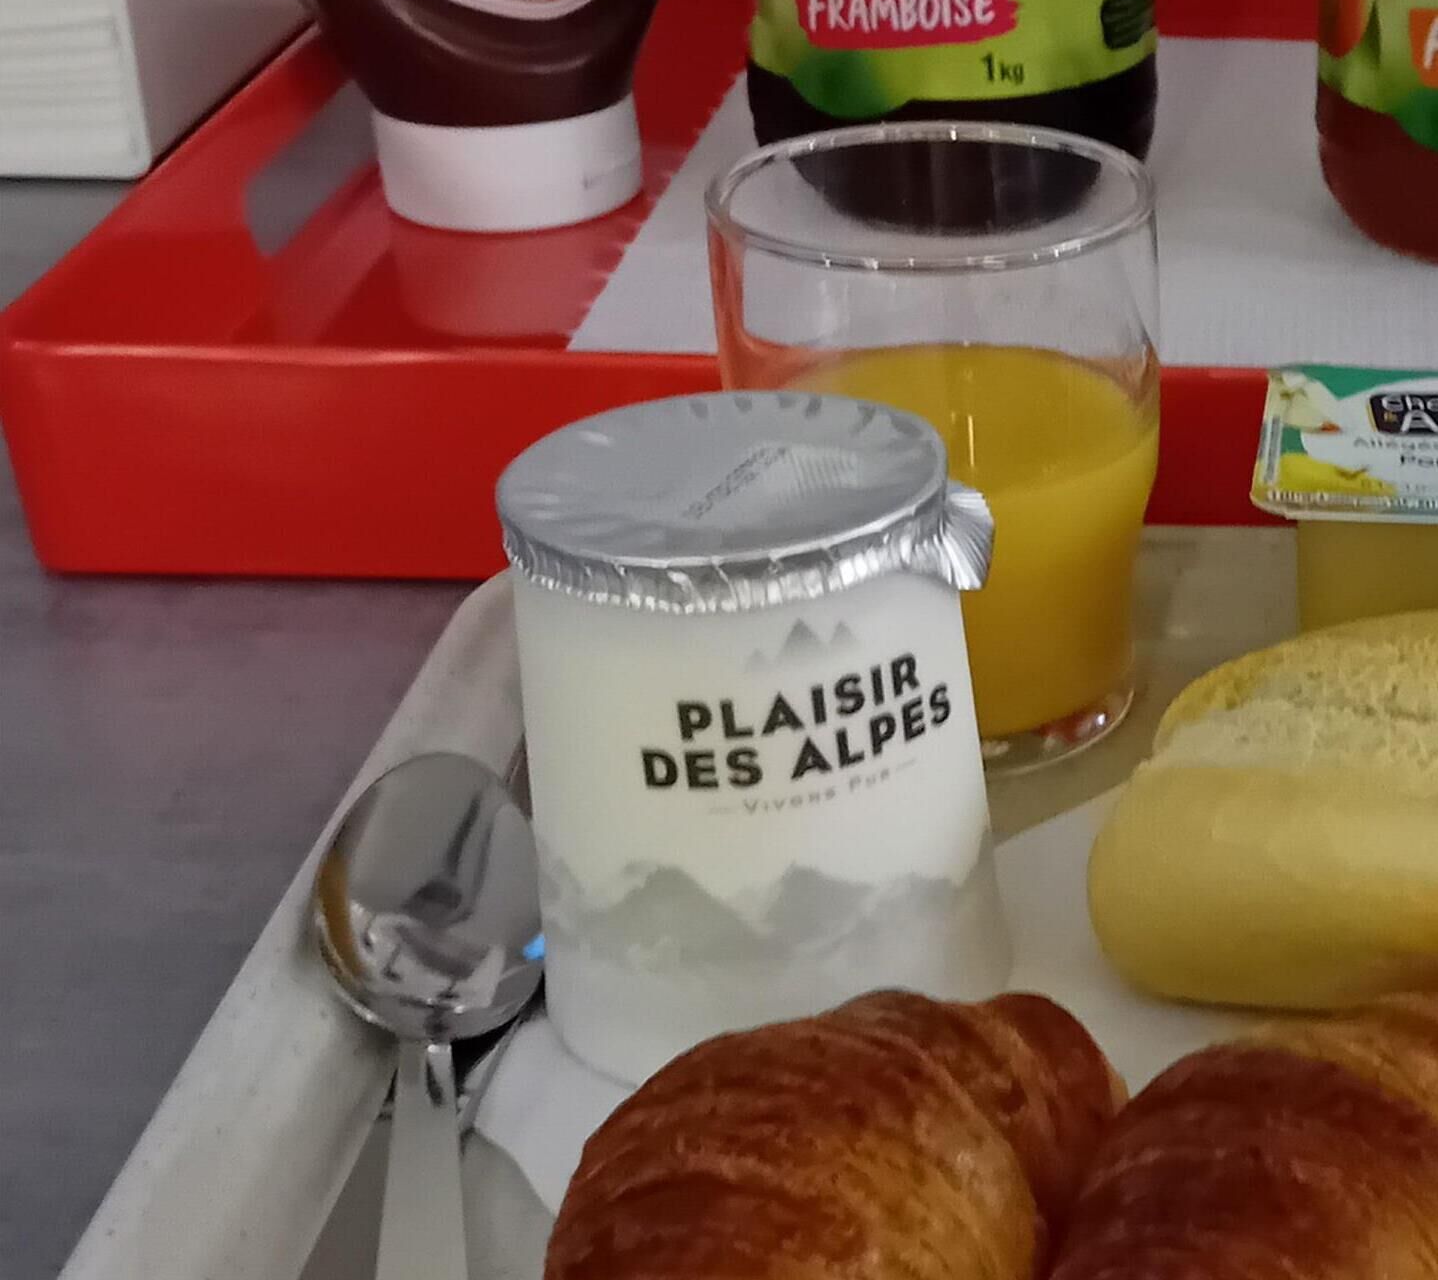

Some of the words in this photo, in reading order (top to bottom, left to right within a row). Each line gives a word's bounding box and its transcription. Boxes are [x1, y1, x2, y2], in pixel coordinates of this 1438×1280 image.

[639, 747, 764, 792] DES
[790, 683, 953, 783] ALPES
[676, 651, 921, 743] PLAISIR
